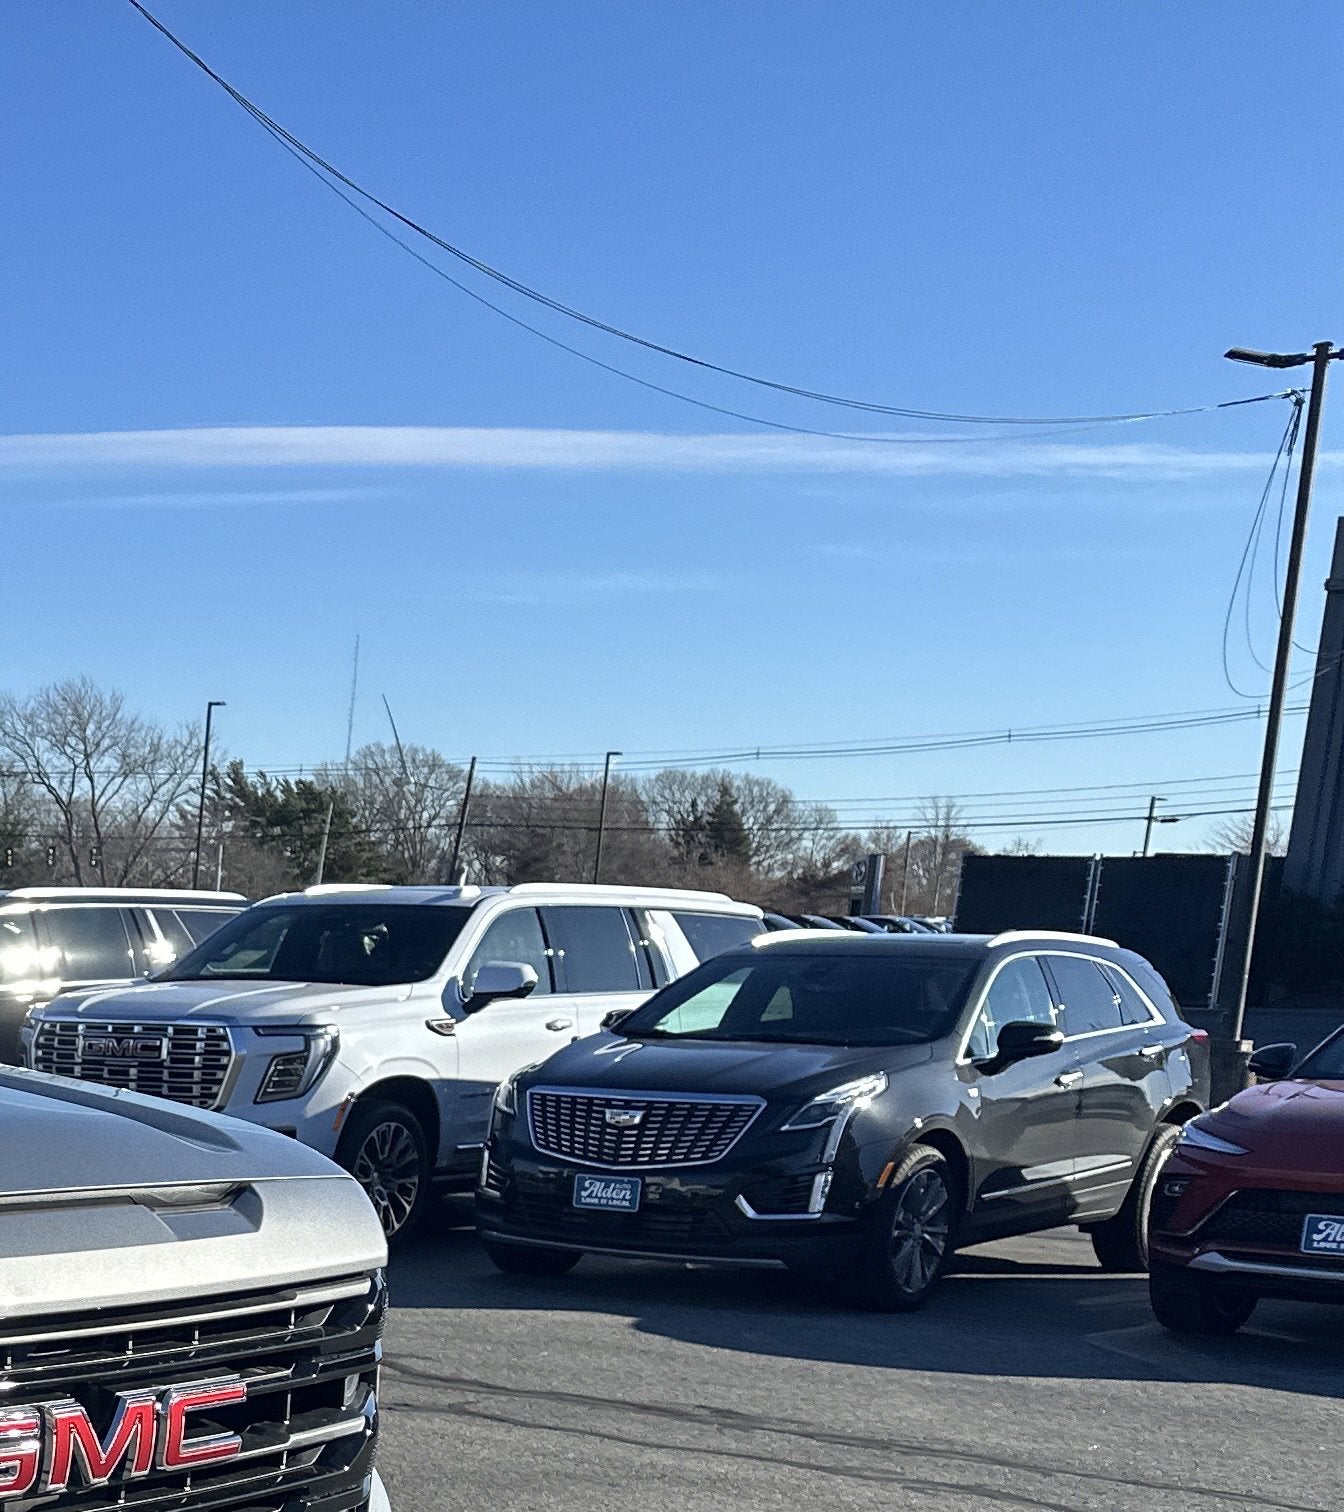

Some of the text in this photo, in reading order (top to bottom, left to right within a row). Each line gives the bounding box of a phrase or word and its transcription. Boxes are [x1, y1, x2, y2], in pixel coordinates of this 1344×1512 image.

[83, 1037, 161, 1057] GMC
[581, 1179, 632, 1200] Alden
[608, 1199, 631, 1207] LOCAL
[1313, 1241, 1338, 1249] LOVE
